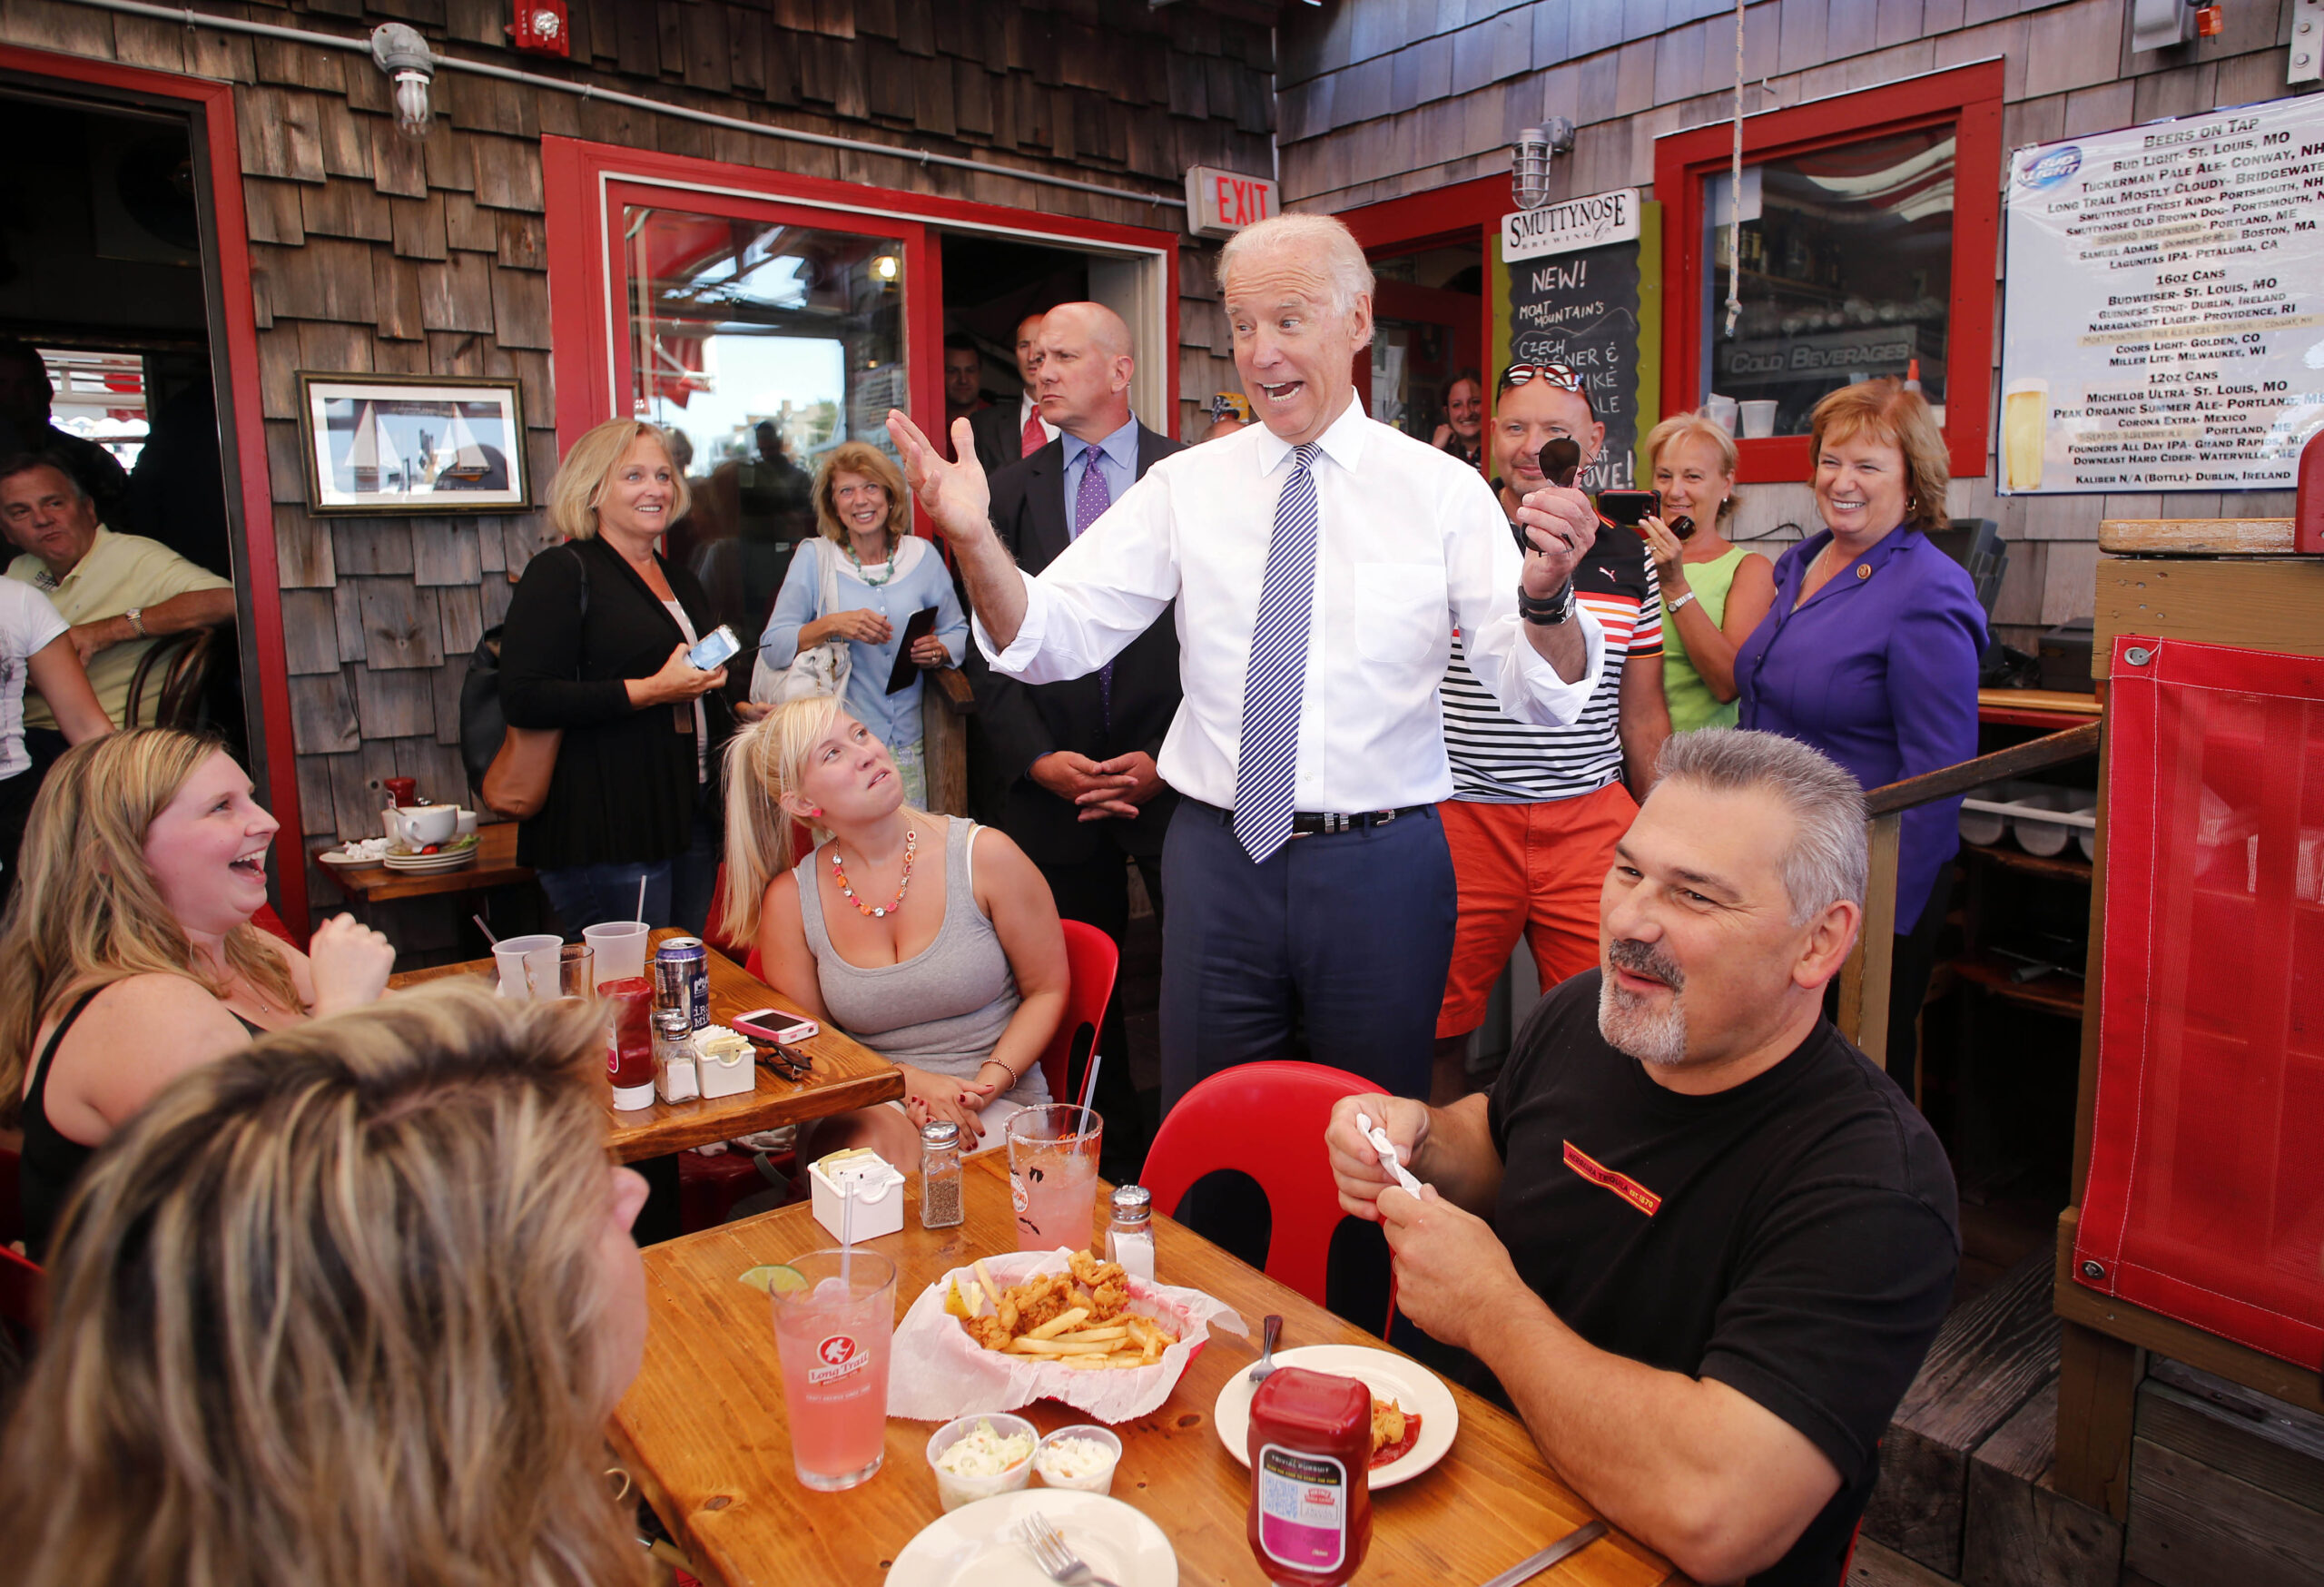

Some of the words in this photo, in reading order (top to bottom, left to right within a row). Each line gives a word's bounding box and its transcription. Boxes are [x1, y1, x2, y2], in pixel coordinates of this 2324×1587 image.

[2143, 130, 2194, 148] BEERS
[2200, 124, 2221, 138] ON
[2228, 118, 2260, 133] TAP
[2037, 154, 2076, 168] BUD
[2113, 159, 2139, 172] BUD
[2188, 147, 2208, 159] ST.
[2213, 140, 2258, 155] LOUIS,
[2263, 131, 2290, 146] MO
[2023, 163, 2080, 181] LIGHT
[2082, 173, 2155, 193] TUCKERMAN
[2159, 167, 2191, 181] PALE
[2196, 163, 2227, 174] ALE-
[2231, 150, 2295, 168] CONWAY,
[2300, 143, 2324, 157] NH
[1216, 175, 1269, 226] EXIT
[2048, 202, 2079, 213] LONG
[2083, 196, 2116, 209] TRAIL
[2120, 186, 2170, 202] MOSTLY
[2079, 207, 2143, 222] SMUTTYNOSE
[2146, 200, 2181, 212] FINEST
[2220, 182, 2299, 202] PORTSMOUTH,
[2303, 176, 2324, 189] NH
[1510, 193, 1626, 248] SMUTTYNOSE
[2066, 219, 2129, 236] SMUTTYNOSE
[2132, 217, 2153, 228] OLD
[2158, 211, 2197, 223] BROWN
[2201, 208, 2229, 218] DOG-
[2232, 194, 2312, 213] PORTSMOUTH,
[2210, 214, 2271, 230] PORTLAND,
[2276, 209, 2298, 221] ME
[1521, 232, 1590, 250] BREWING
[2080, 248, 2119, 261] SAMUEL
[2122, 242, 2159, 255] ADAMS
[2241, 225, 2290, 240] BOSTON,
[2294, 220, 2316, 232] MA
[2110, 256, 2164, 270] LAGUNITAS
[2196, 244, 2257, 259] PETALUMA,
[2260, 239, 2279, 250] CA
[1531, 260, 1587, 294] NEW!
[2192, 269, 2226, 281] CANS
[2183, 287, 2202, 298] ST.
[2207, 282, 2248, 295] LOUIS,
[2252, 277, 2277, 290] MO
[1519, 300, 1552, 320] MOAT
[1534, 301, 1605, 328] MOUNTAIN'S
[2099, 307, 2149, 320] GUINNESS
[2191, 299, 2234, 310] DUBLIN,
[2238, 292, 2286, 305] IRELAND
[2203, 307, 2277, 321] PROVIDENCE,
[2280, 303, 2296, 314] RI
[1519, 339, 1566, 359] CZECH
[2116, 345, 2151, 354] COORS
[2191, 337, 2238, 348] GOLDEN,
[2242, 333, 2260, 343] CO
[1730, 351, 1784, 374] COLD
[1790, 342, 1909, 370] BEVERAGES
[2109, 357, 2146, 367] MILLER
[2178, 350, 2245, 361] MILWAUKEE,
[2250, 346, 2266, 356] WI
[1586, 365, 1618, 390] IKE
[2185, 370, 2219, 381] CANS
[2086, 392, 2144, 403] MICHELOB
[2193, 386, 2212, 397] ST.
[2217, 384, 2258, 395] LOUIS,
[2262, 380, 2288, 392] MO
[2053, 409, 2082, 419] PEAK
[2085, 406, 2136, 417] ORGANIC
[2139, 403, 2191, 414] SUMMER
[2195, 400, 2223, 410] ALE-
[2118, 419, 2160, 428] CORONA
[2203, 414, 2247, 423] MEXICO
[2206, 426, 2267, 435] PORTLAND,
[2271, 422, 2292, 432] ME
[2068, 445, 2118, 454] FOUNDERS
[2122, 443, 2140, 451] ALL
[2142, 441, 2163, 450] DAY
[2195, 439, 2233, 448] GRAND
[1580, 449, 1635, 489] OVE!
[2073, 457, 2125, 465] DOWNEAST
[2129, 455, 2157, 463] HARD
[2075, 474, 2116, 484] KALIBER
[2119, 473, 2142, 484] N/A
[2196, 471, 2239, 481] DUBLIN,
[2242, 470, 2291, 479] IRELAND
[811, 1368, 840, 1381] Long
[841, 1353, 868, 1372] Trail
